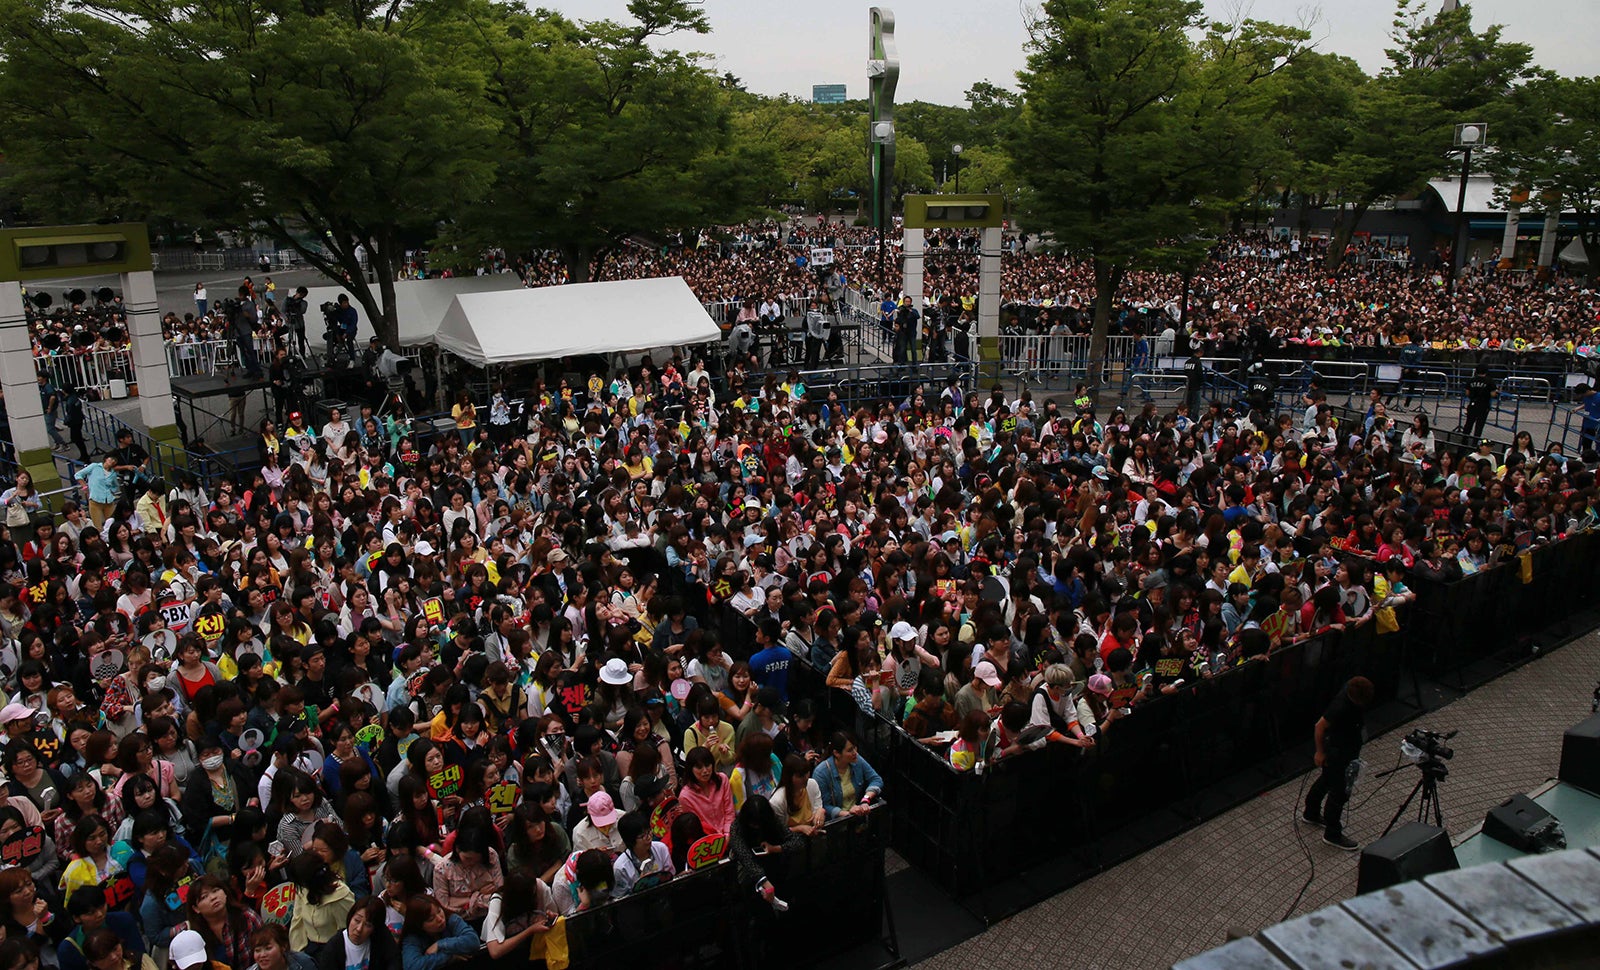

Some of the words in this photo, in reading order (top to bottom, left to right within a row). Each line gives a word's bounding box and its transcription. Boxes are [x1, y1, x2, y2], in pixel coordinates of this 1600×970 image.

[714, 578, 731, 598] 슈
[162, 603, 190, 625] CBX
[423, 599, 443, 622] 백
[194, 613, 225, 641] 첸
[765, 660, 789, 673] STAFF
[561, 683, 585, 713] 첸
[429, 764, 461, 789] 종대
[437, 782, 460, 799] CHEN
[489, 784, 516, 814] 첸
[1, 833, 42, 861] 백현
[694, 837, 725, 868] 첸
[264, 883, 296, 913] 종대
